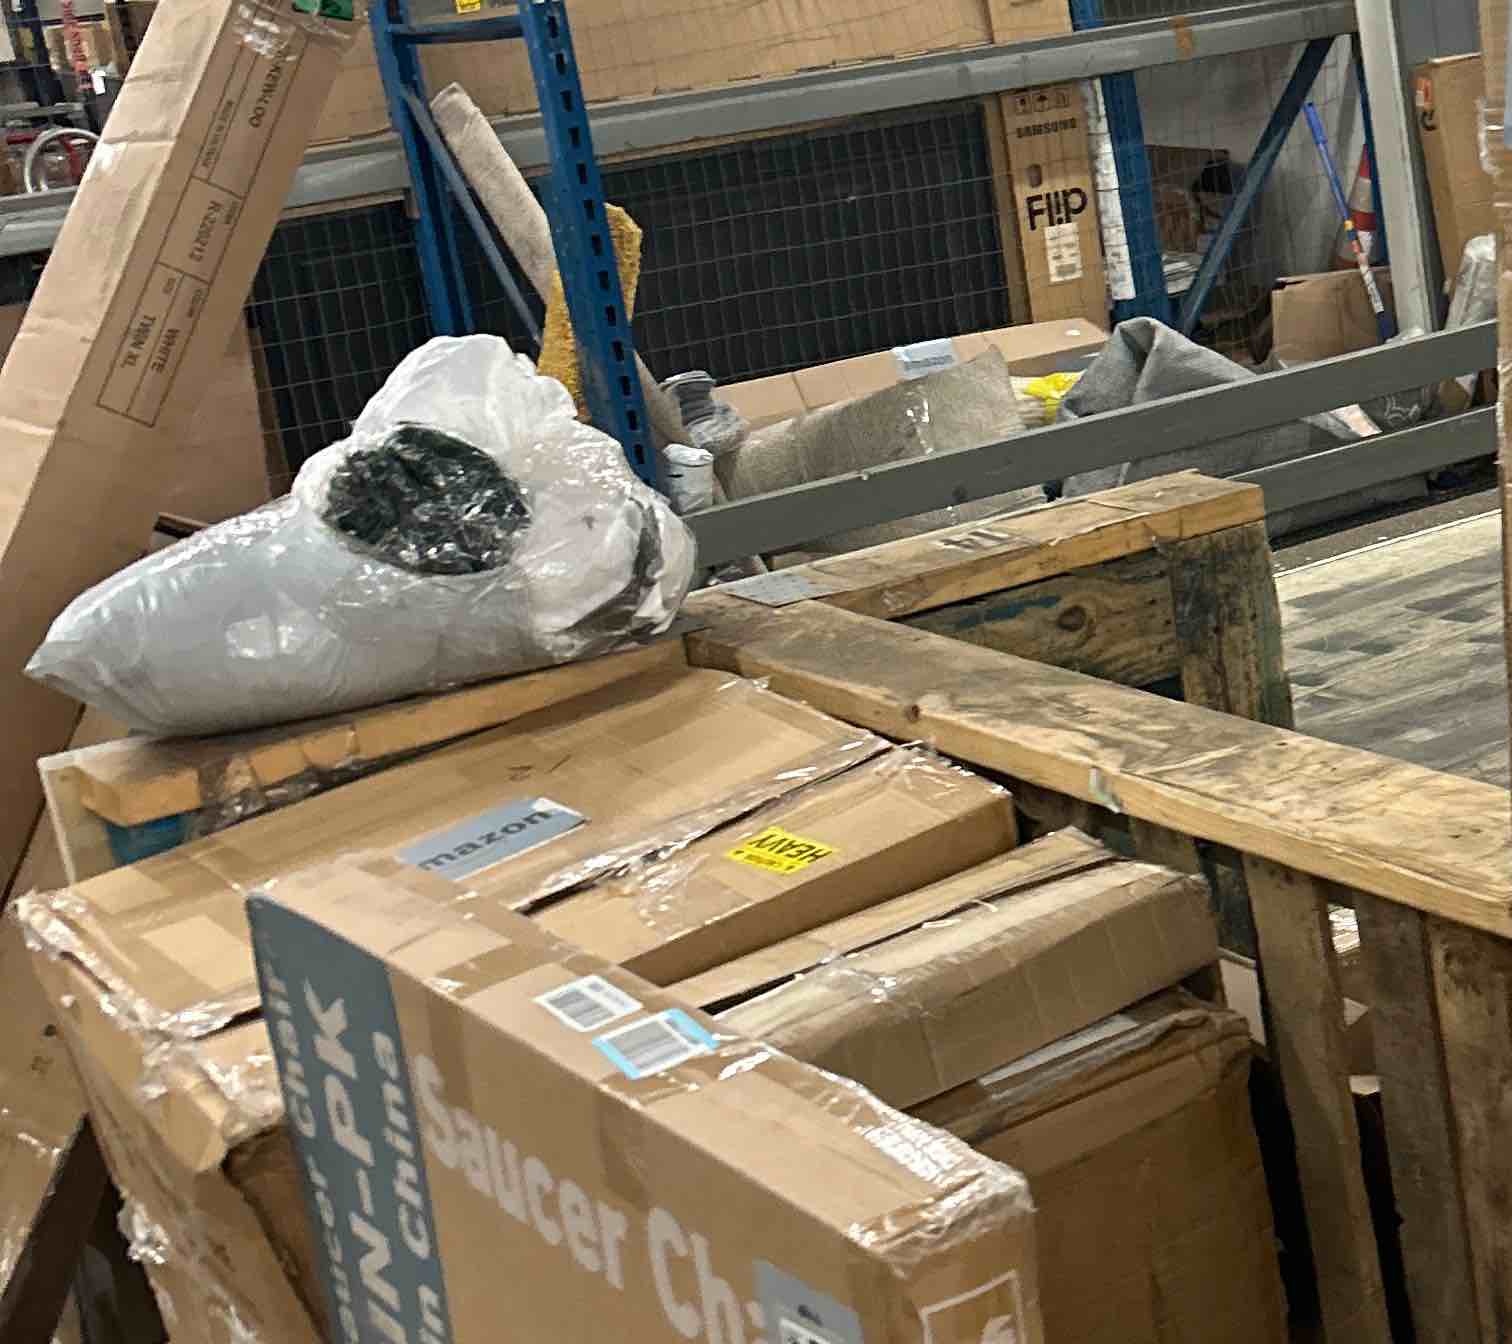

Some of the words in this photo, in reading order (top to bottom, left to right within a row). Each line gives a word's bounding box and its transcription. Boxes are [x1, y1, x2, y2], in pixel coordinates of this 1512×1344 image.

[136, 315, 157, 351] TWIN
[152, 328, 181, 374] WHITE
[372, 1030, 432, 1260] China
[413, 1054, 629, 1290] Saucer
